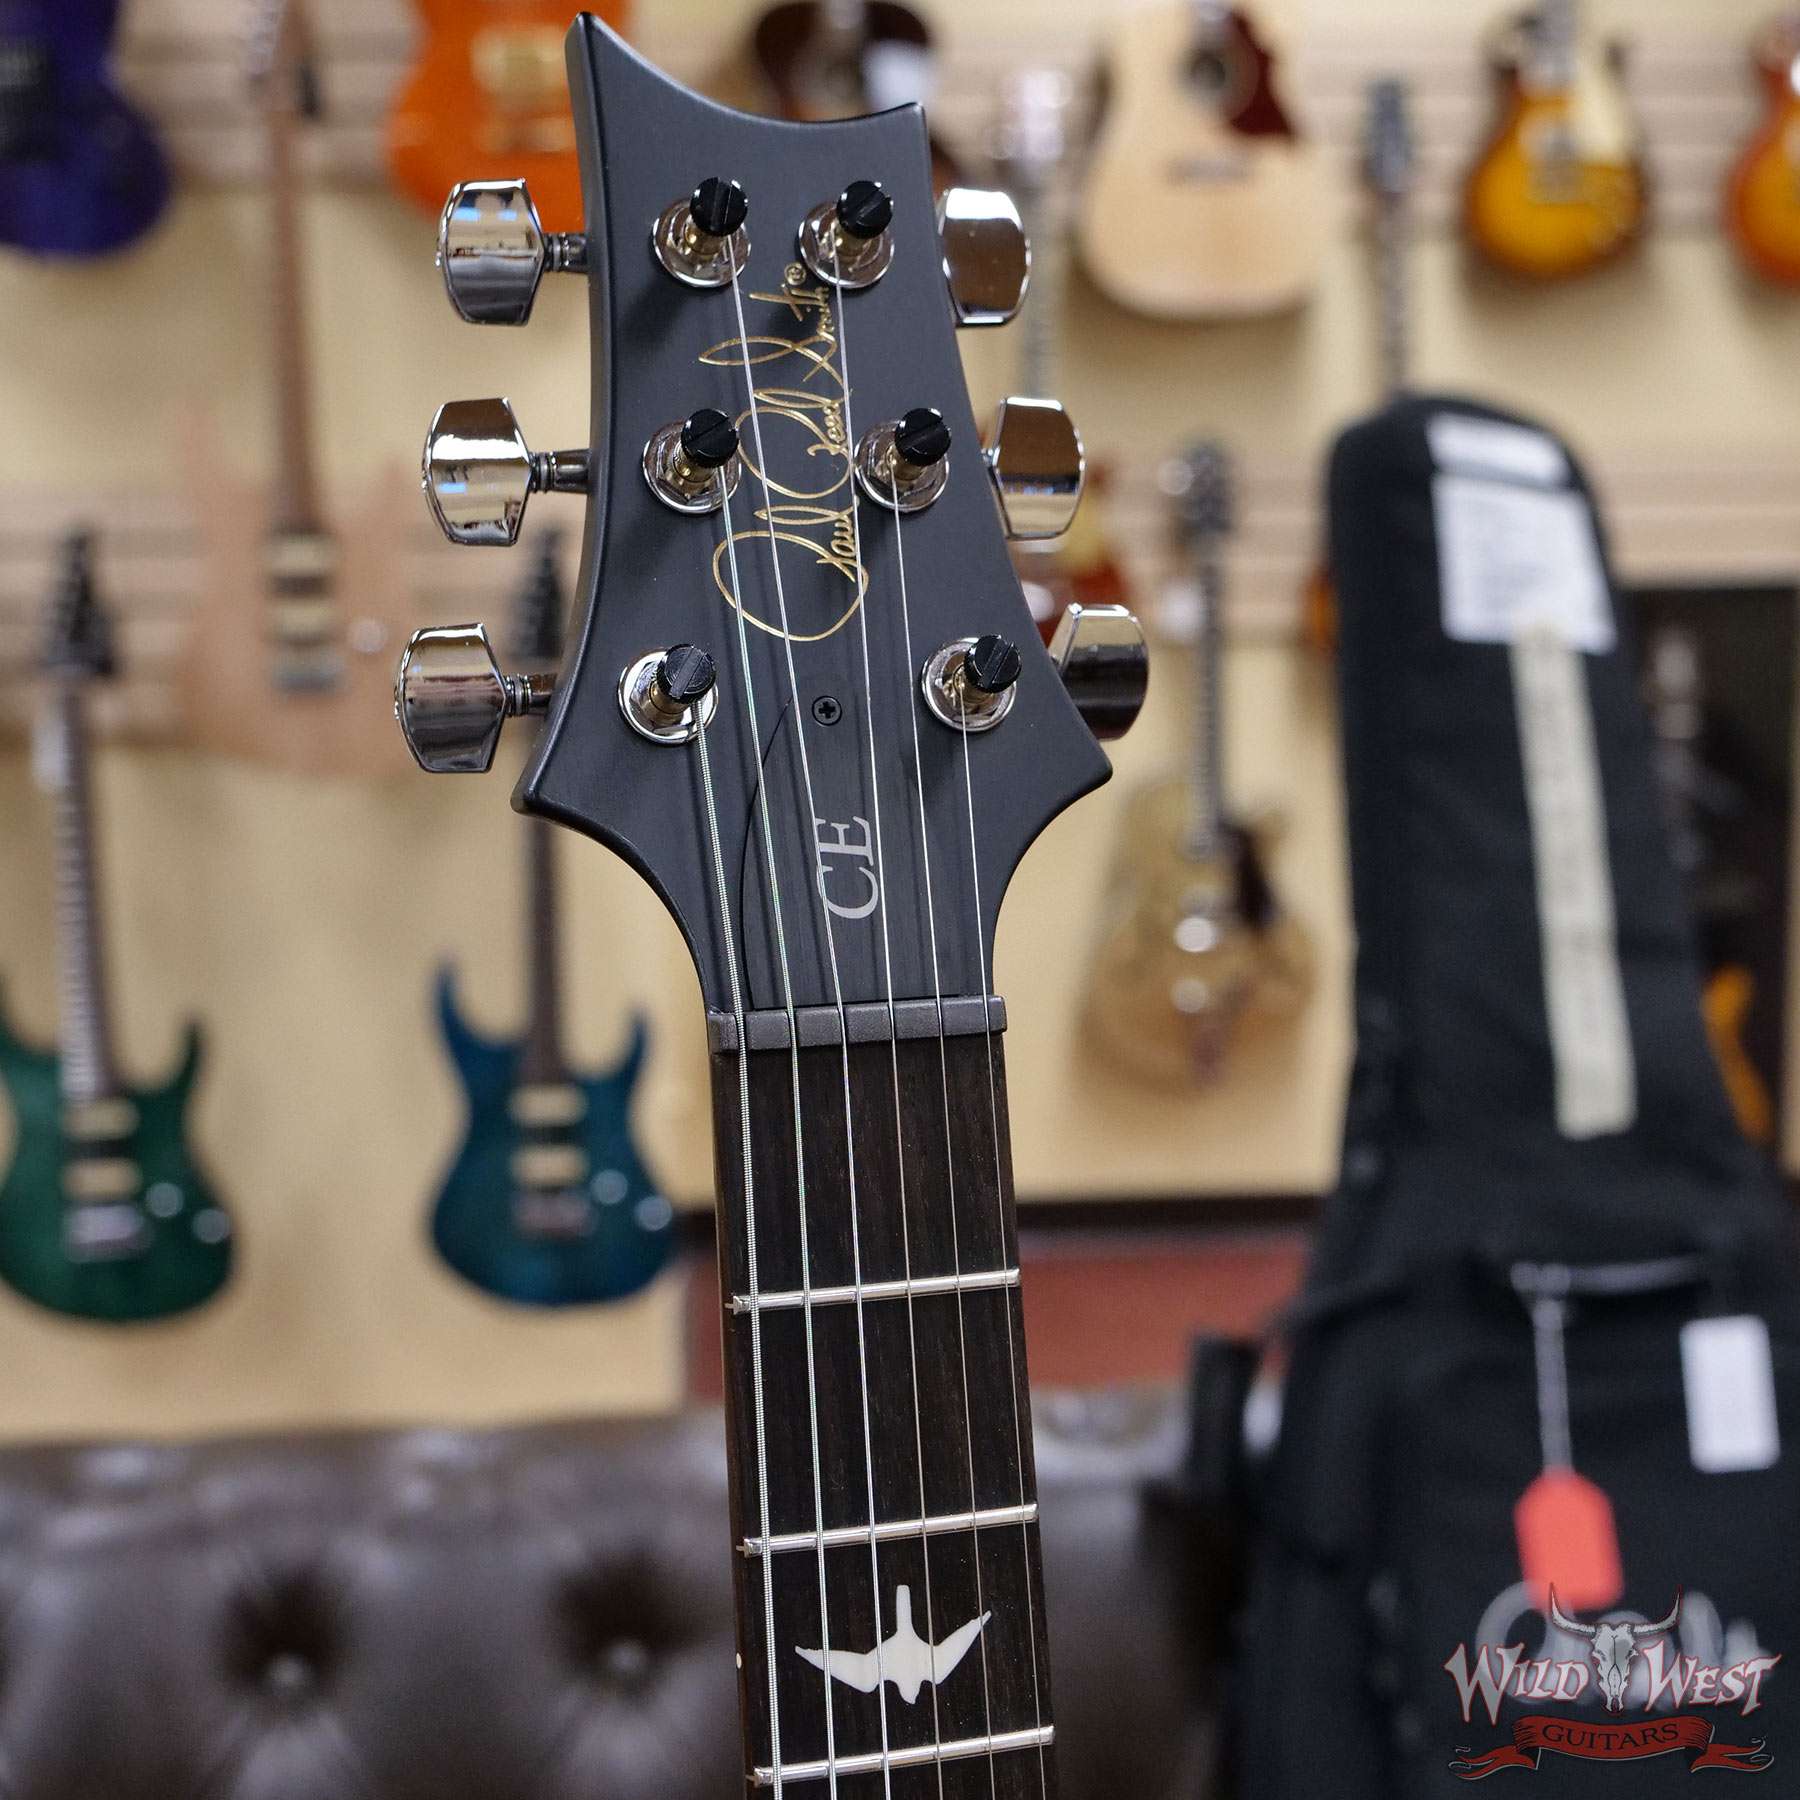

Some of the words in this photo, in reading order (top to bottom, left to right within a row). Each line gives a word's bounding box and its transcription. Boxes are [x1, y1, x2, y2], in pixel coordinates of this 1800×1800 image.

[735, 388, 852, 499] Reed
[712, 496, 869, 642] Paul
[815, 815, 879, 920] CE
